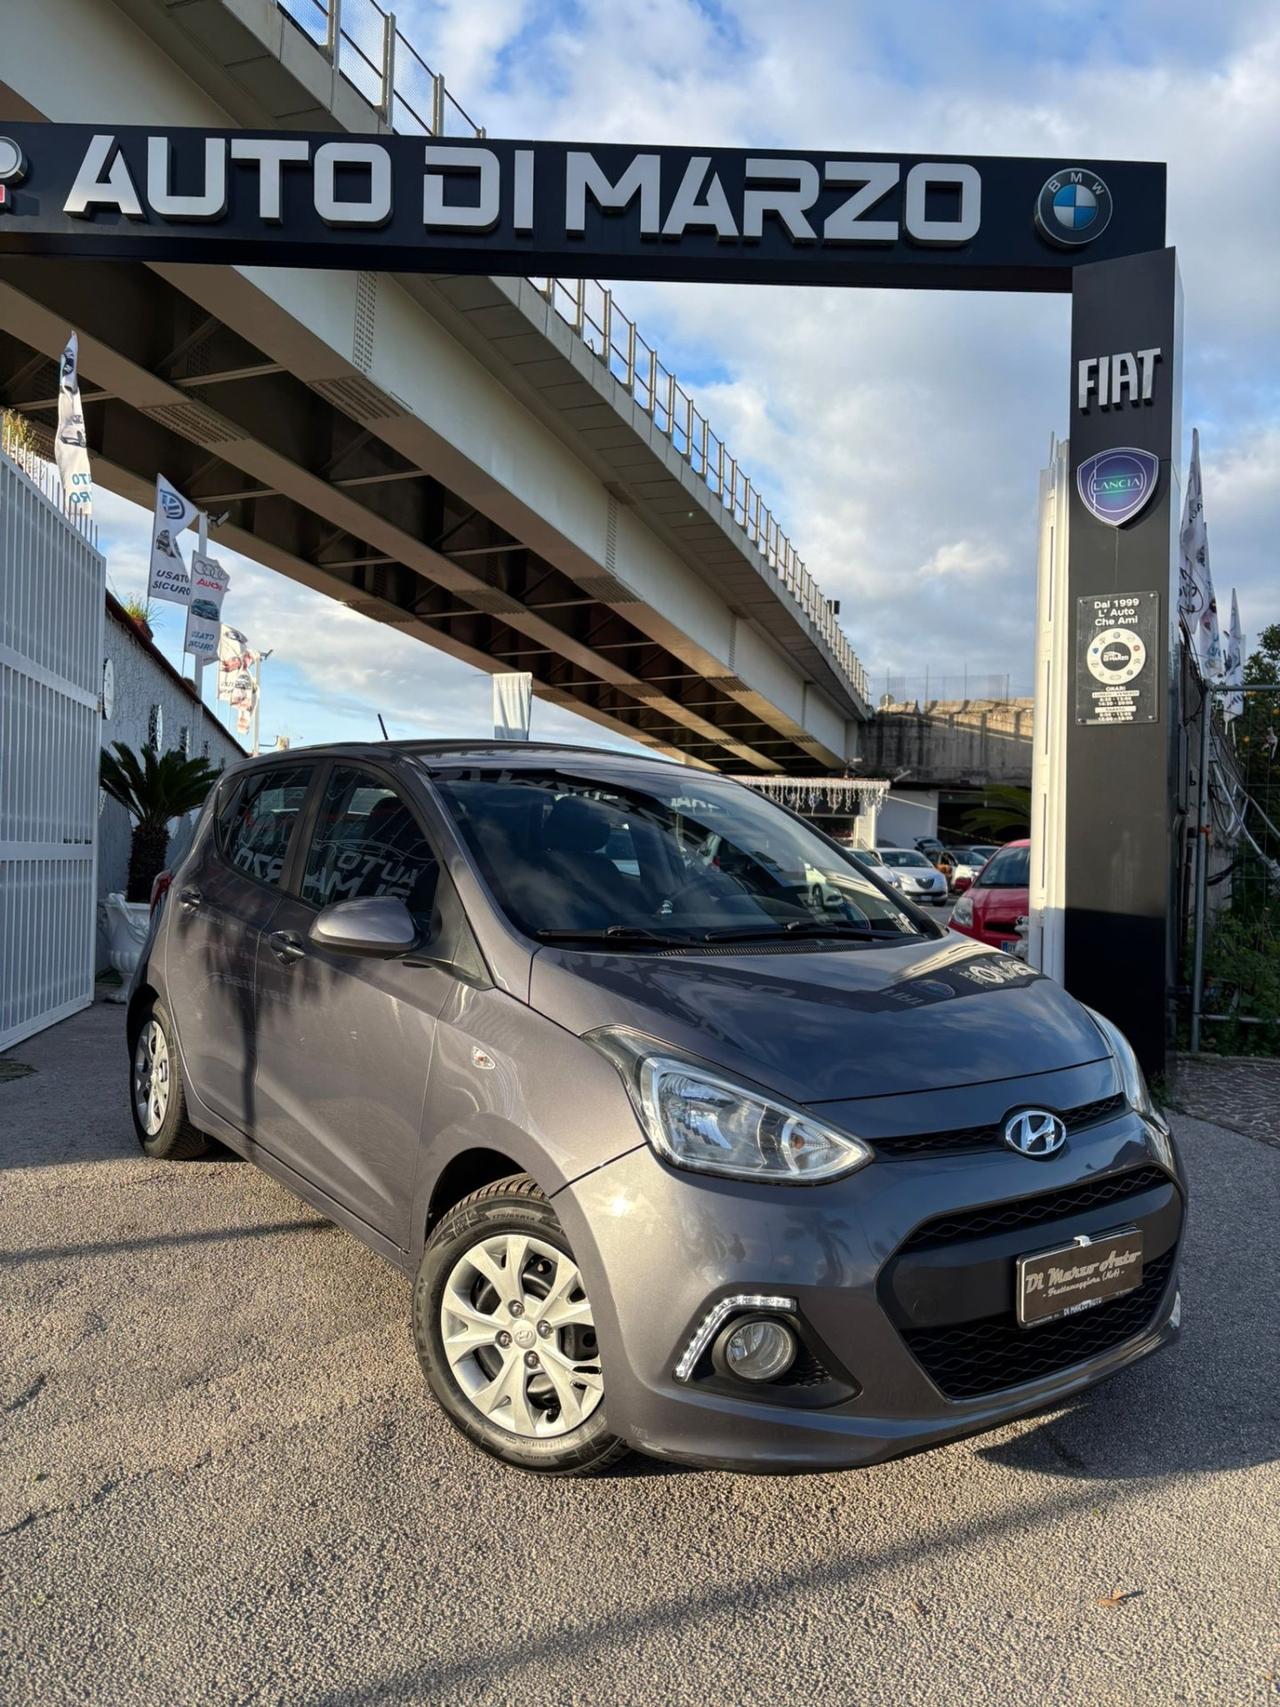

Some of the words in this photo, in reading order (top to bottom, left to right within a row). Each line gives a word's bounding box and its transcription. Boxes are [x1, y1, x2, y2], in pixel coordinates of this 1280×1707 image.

[63, 135, 393, 229] AUTO
[423, 146, 535, 233] DI
[565, 151, 982, 243] MARZO
[1048, 172, 1105, 195] BMW
[1078, 347, 1161, 409] FIAT
[1094, 478, 1141, 491] LANCIA
[152, 580, 191, 596] SICURO
[1094, 600, 1110, 609] Dal
[1113, 598, 1139, 608] 1999
[1095, 618, 1115, 626] Che
[1117, 615, 1138, 625] Ami
[1110, 608, 1135, 617] Auto
[1048, 1262, 1100, 1287] Marzo
[1099, 1250, 1142, 1272] Auto
